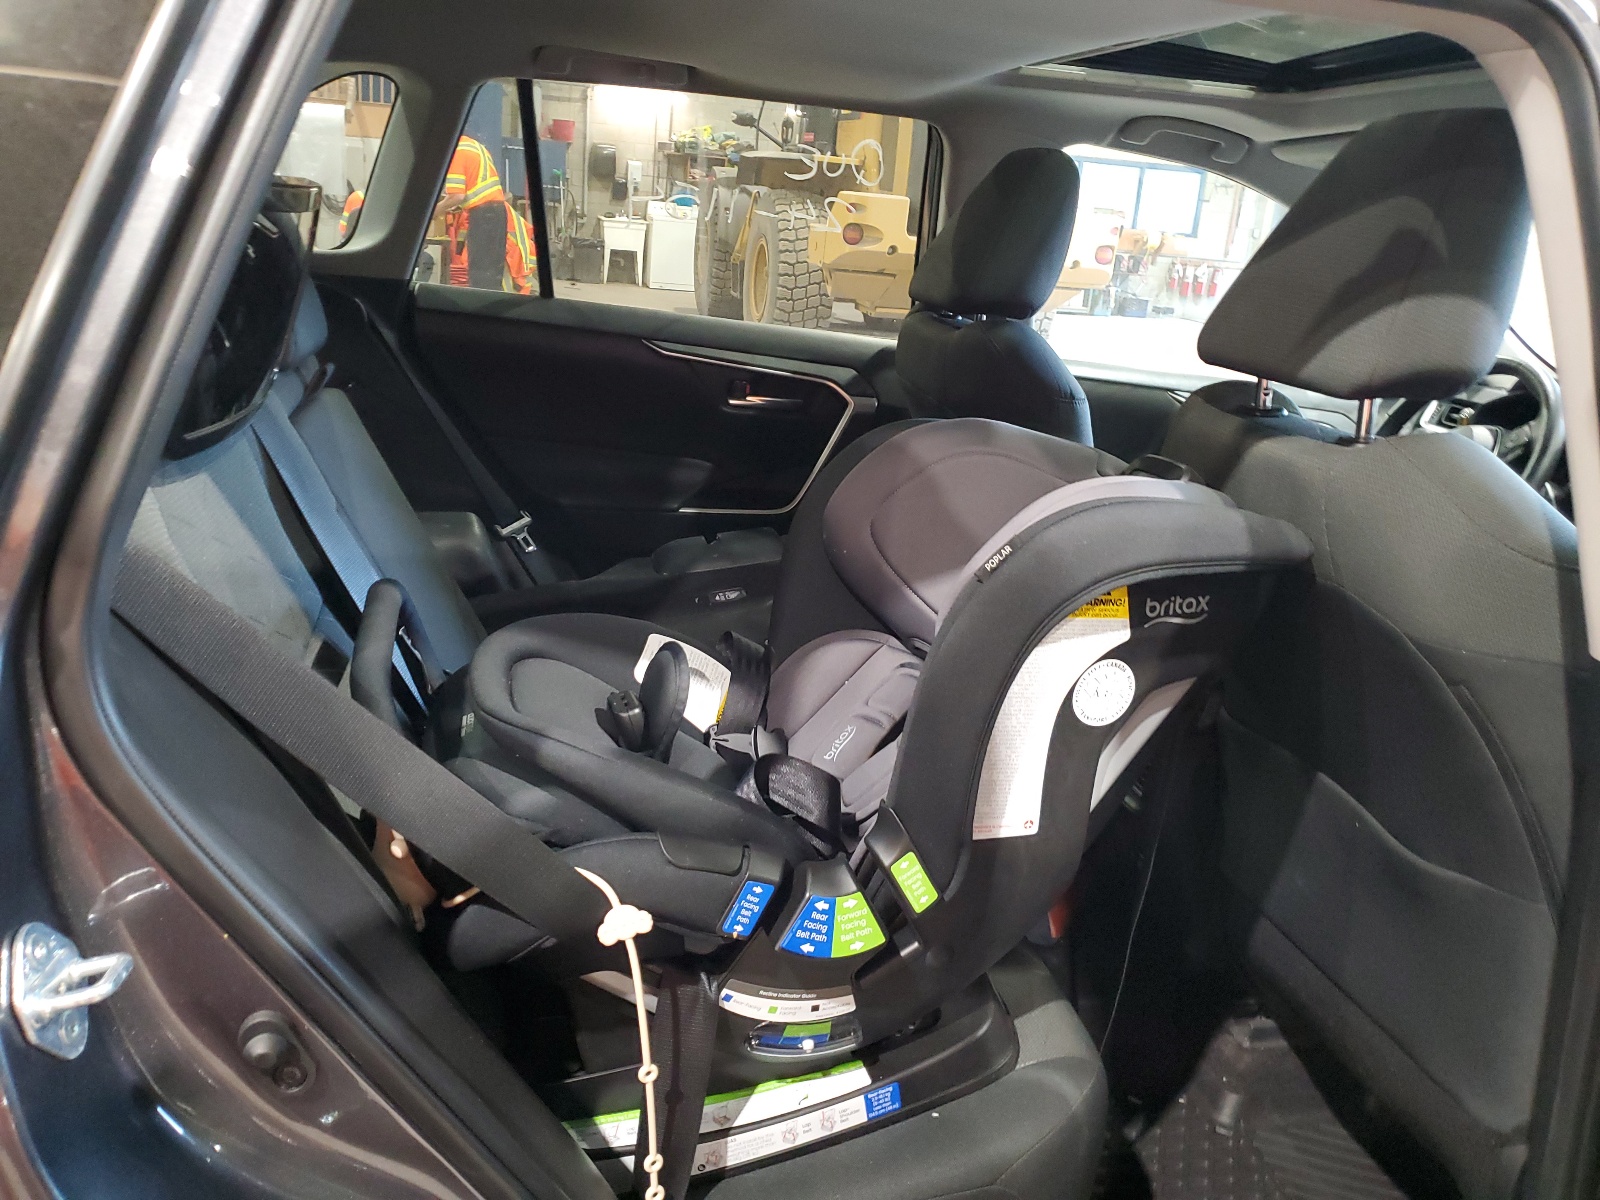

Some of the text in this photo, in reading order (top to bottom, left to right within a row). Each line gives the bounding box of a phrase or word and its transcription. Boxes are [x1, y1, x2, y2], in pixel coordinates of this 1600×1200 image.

[984, 544, 1013, 571] POPLAR
[1086, 598, 1126, 608] ARNING!
[1145, 594, 1210, 618] britax
[823, 725, 854, 760] britax
[746, 893, 760, 903] Rear
[740, 900, 760, 913] Facing
[740, 908, 752, 917] Belt
[736, 915, 750, 925] Path
[811, 911, 828, 921] Rear
[837, 908, 868, 922] Forward
[803, 920, 828, 933] Facing
[841, 918, 867, 931] Facing
[795, 929, 827, 942] Belt Path
[840, 926, 873, 942] Belt Path
